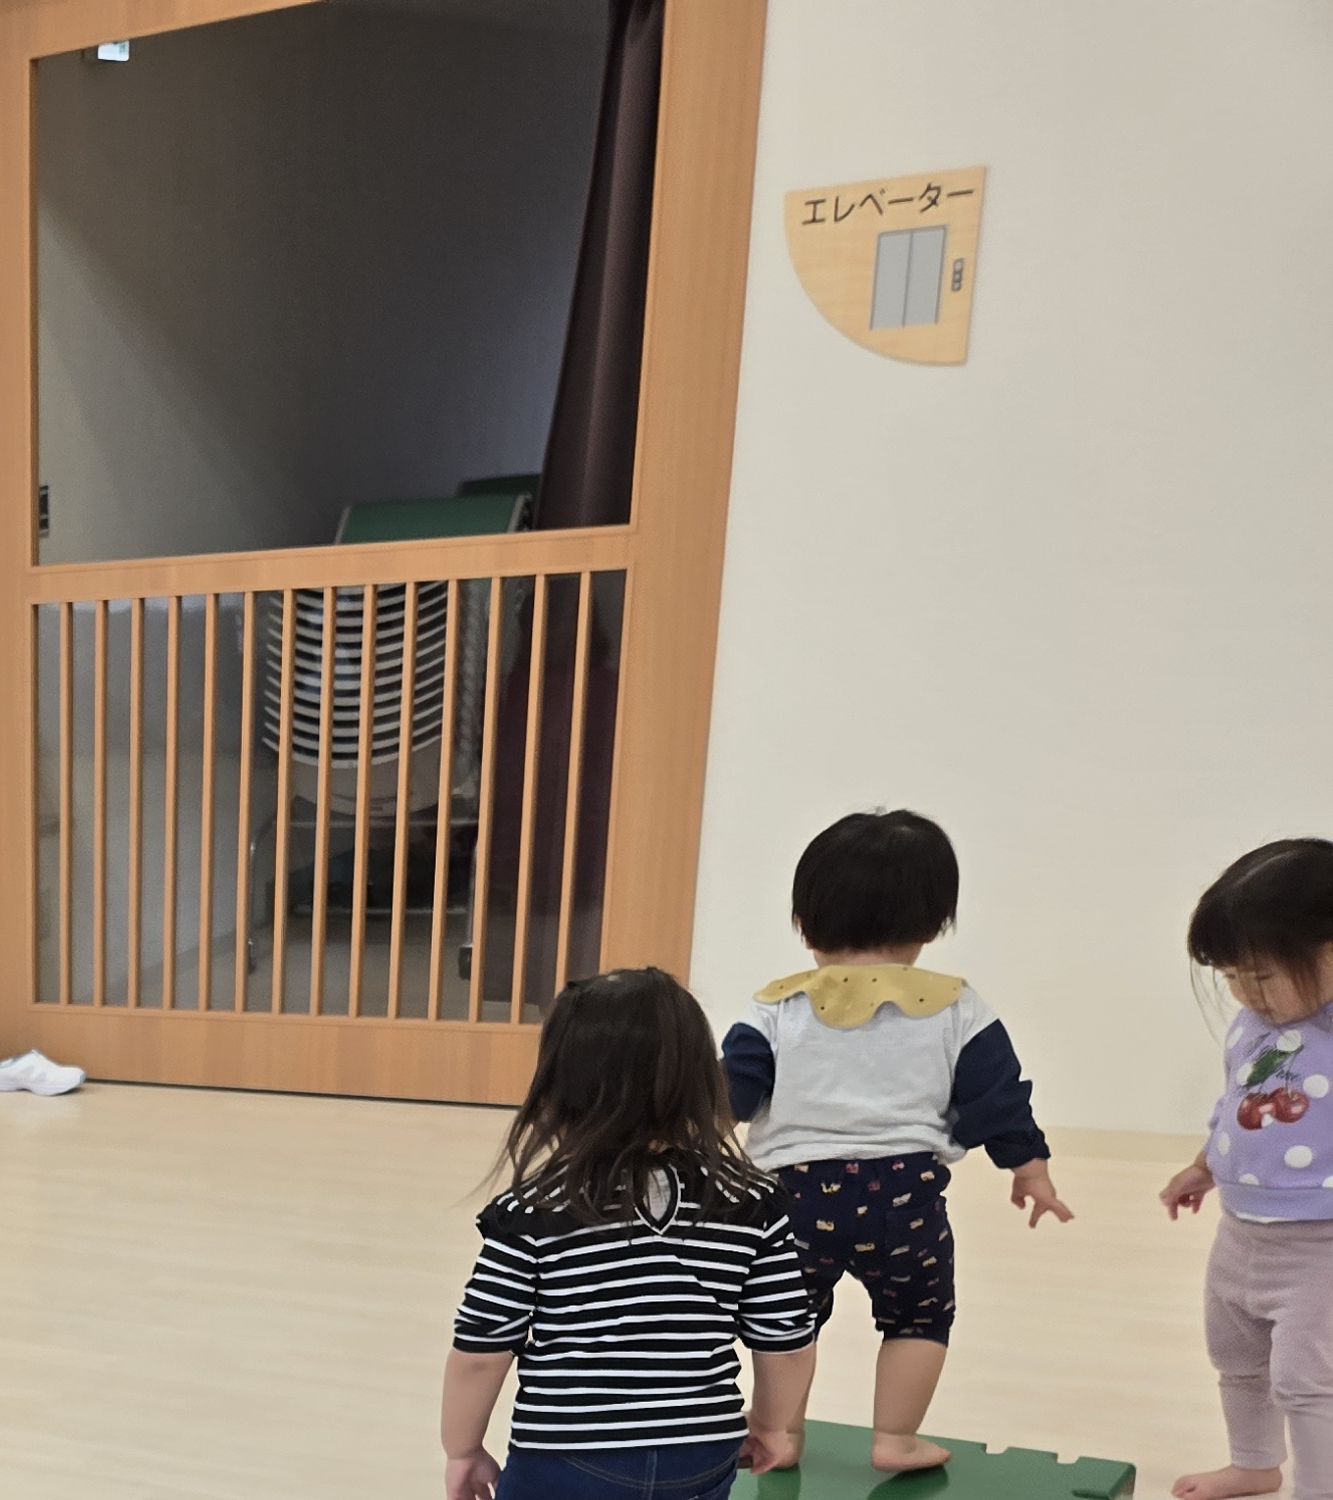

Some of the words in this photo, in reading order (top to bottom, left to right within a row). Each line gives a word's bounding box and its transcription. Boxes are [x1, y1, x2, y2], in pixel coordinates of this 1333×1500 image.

[801, 182, 975, 226] エレベーター
